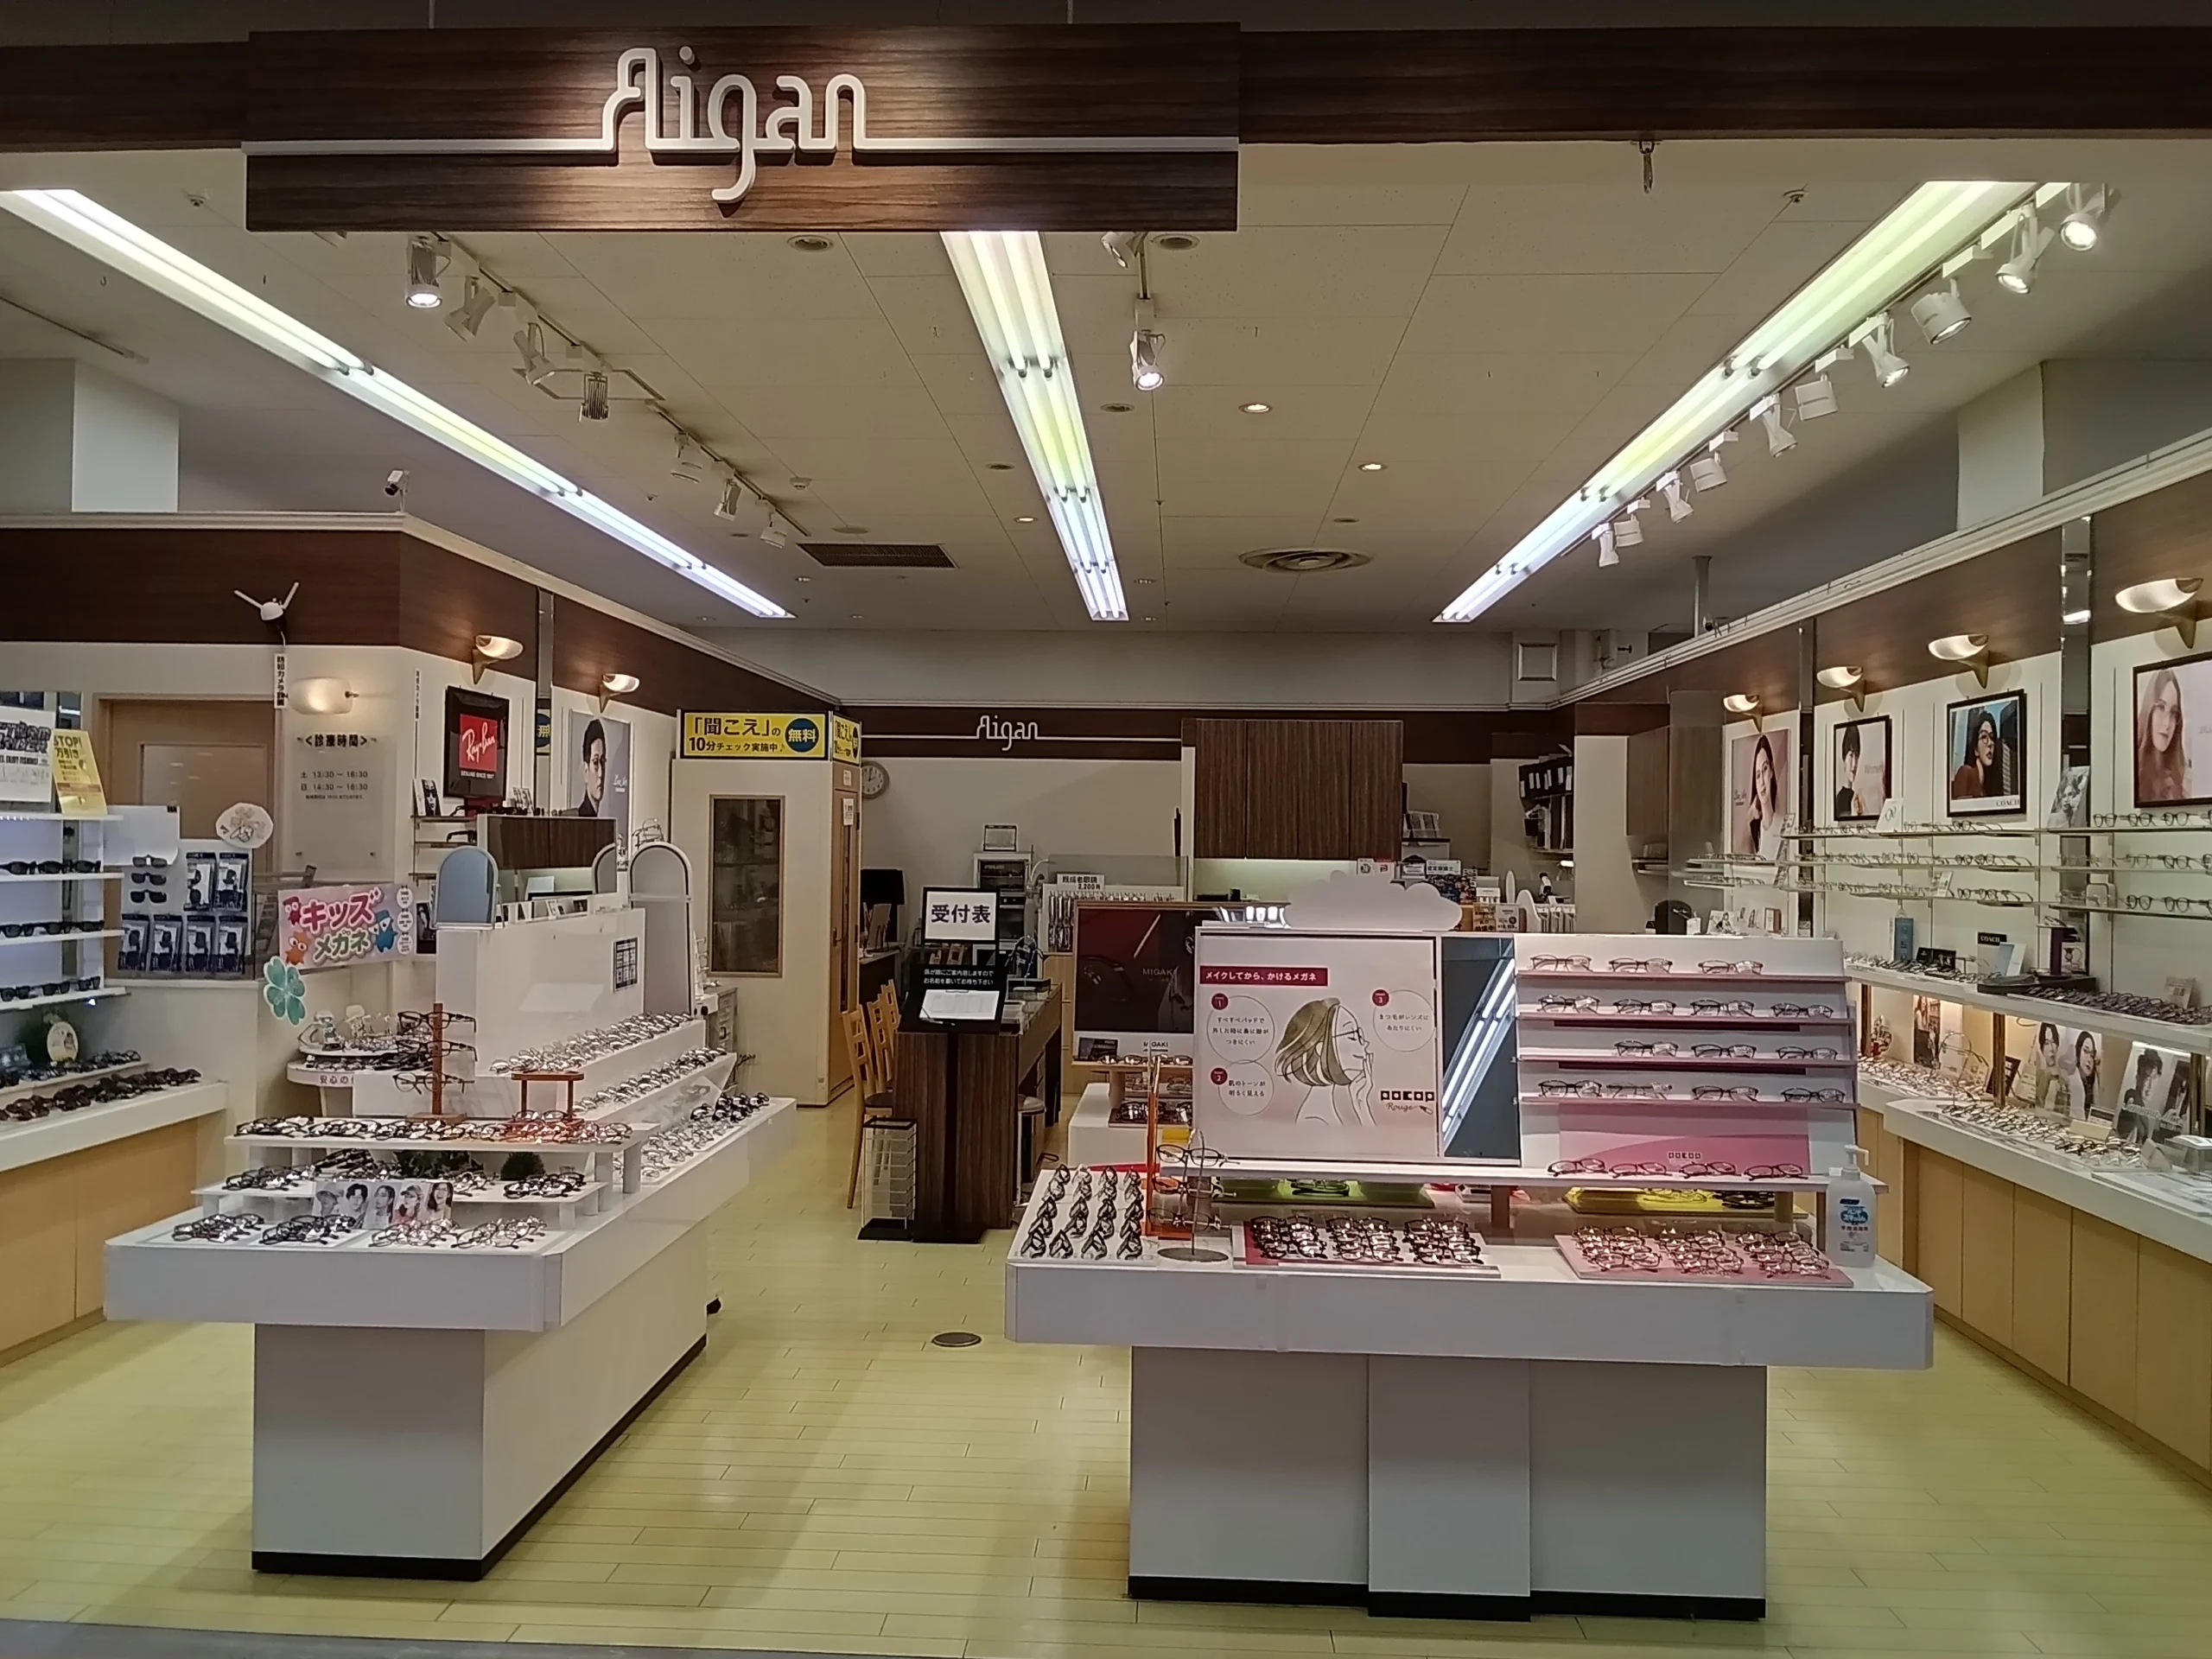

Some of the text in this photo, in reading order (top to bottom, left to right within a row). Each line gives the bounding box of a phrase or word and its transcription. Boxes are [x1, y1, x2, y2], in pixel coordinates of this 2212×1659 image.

[602, 46, 867, 201] Aigan
[694, 717, 781, 737] 「聞こえ」の
[787, 728, 817, 743] 無料
[976, 715, 1039, 751] Aigan
[302, 887, 383, 935] キッズ
[931, 904, 991, 924] 受付表
[313, 929, 370, 962] メガネ
[1205, 971, 1317, 982] メイクしてから、かけるメガネ
[320, 1075, 353, 1084] 安心の
[1385, 1102, 1414, 1112] Rouge
